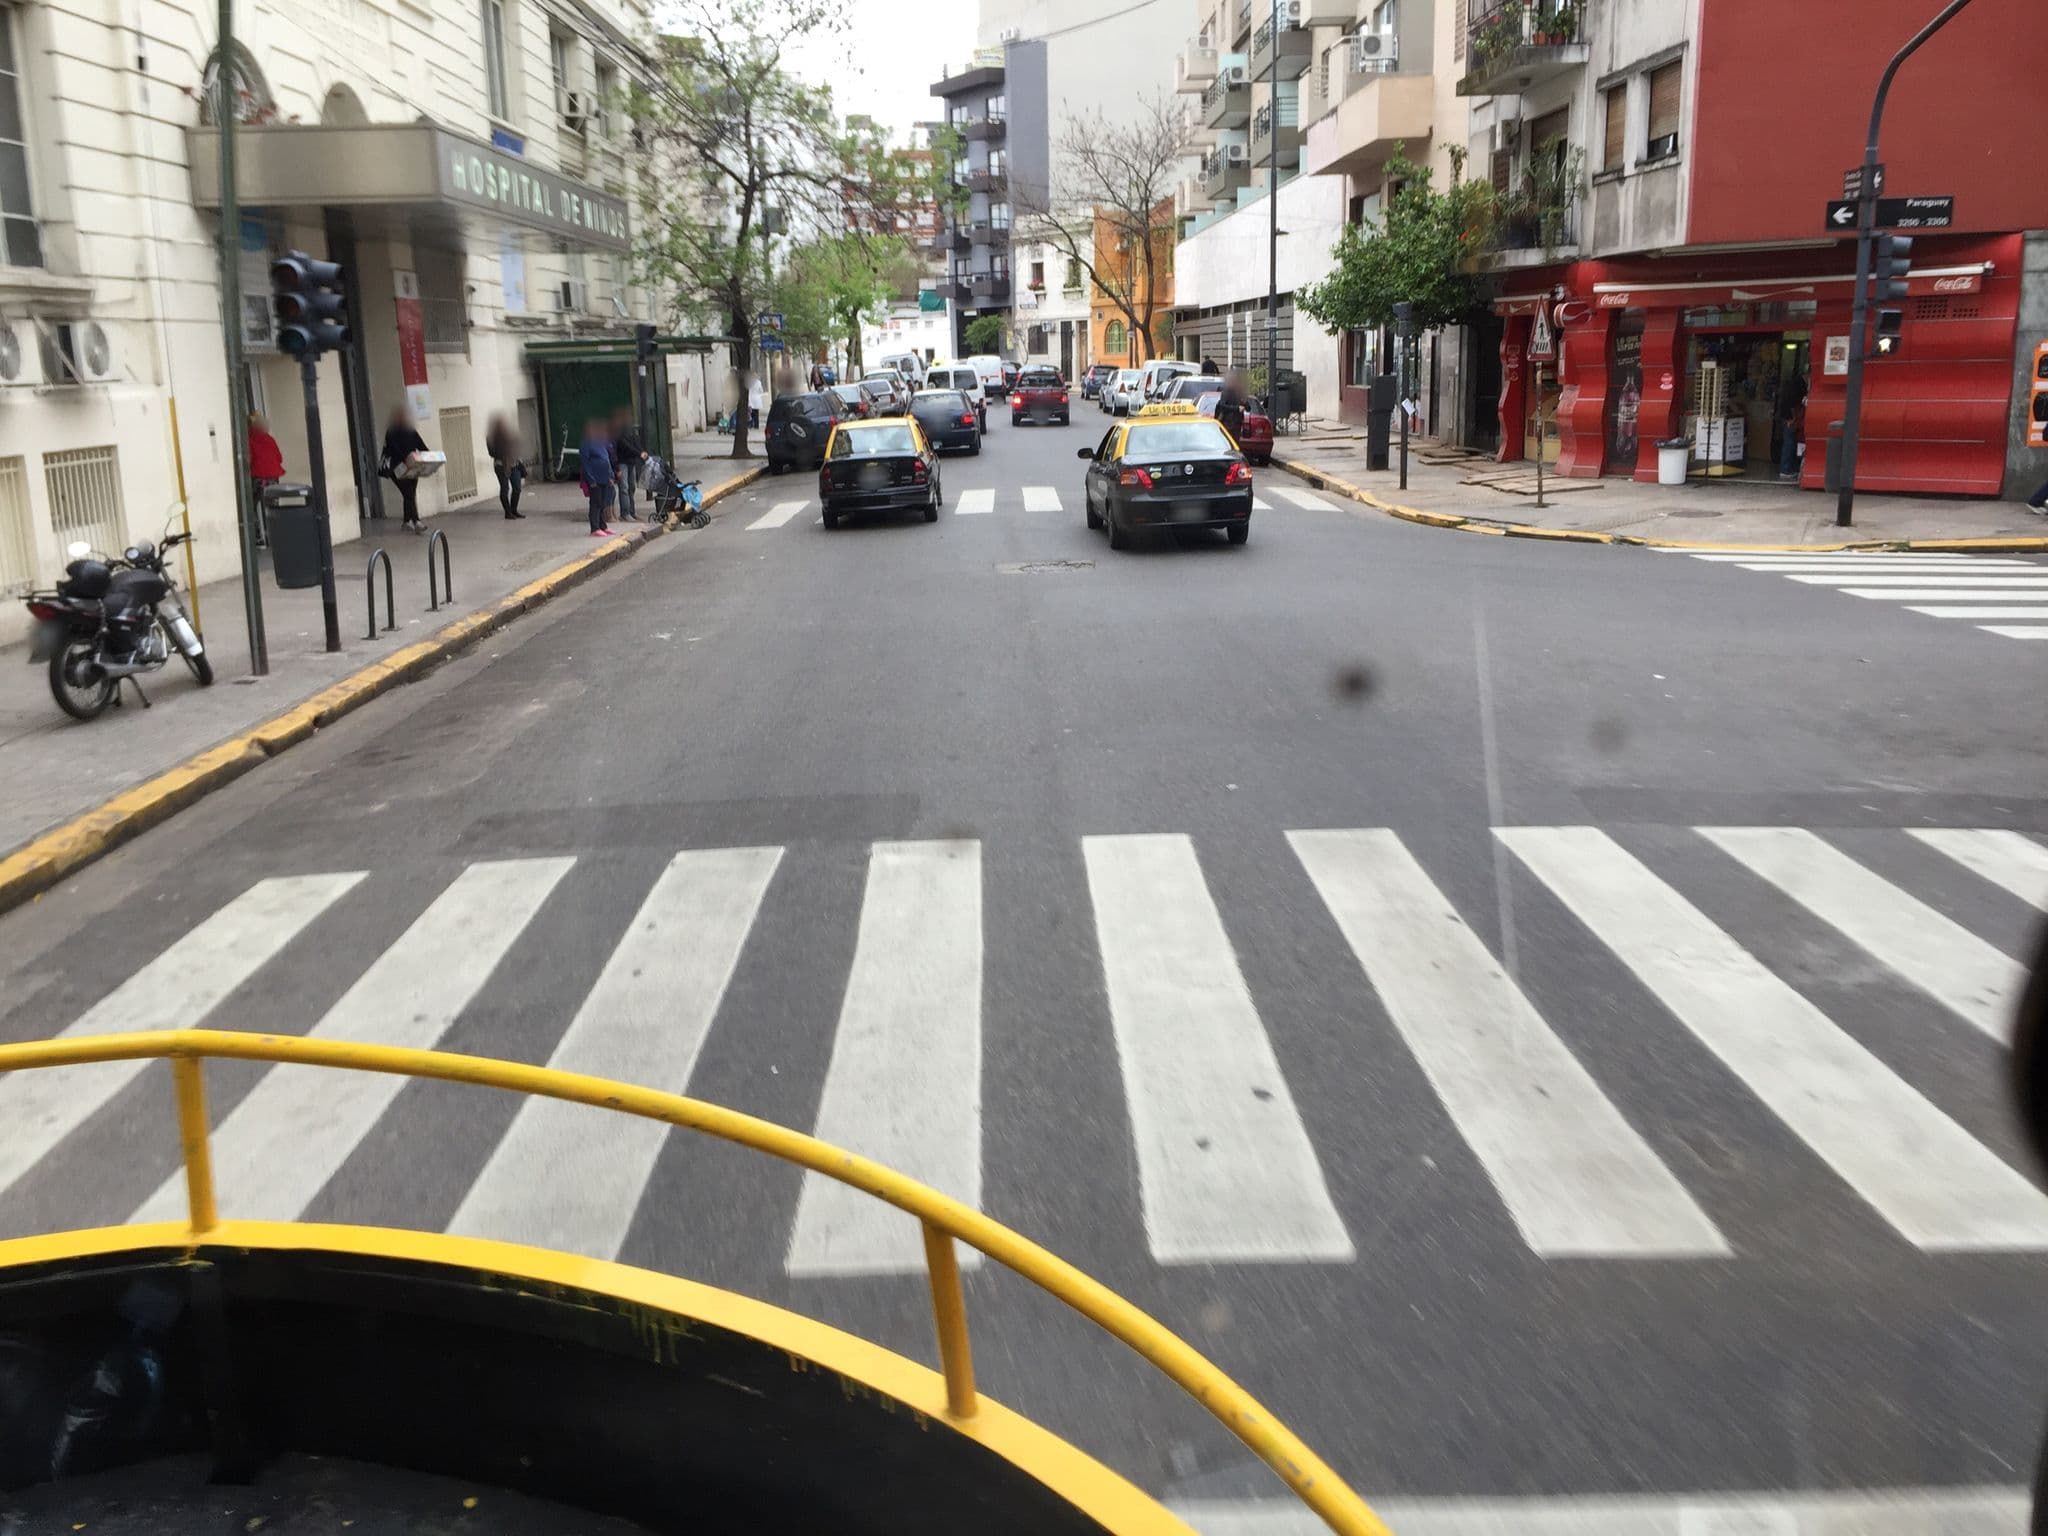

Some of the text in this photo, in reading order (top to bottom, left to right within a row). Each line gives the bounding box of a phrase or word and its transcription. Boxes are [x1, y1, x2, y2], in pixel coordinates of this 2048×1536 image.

[452, 152, 554, 216] HOSPITAL
[560, 189, 581, 226] DE
[1906, 198, 1950, 208] Paraguay
